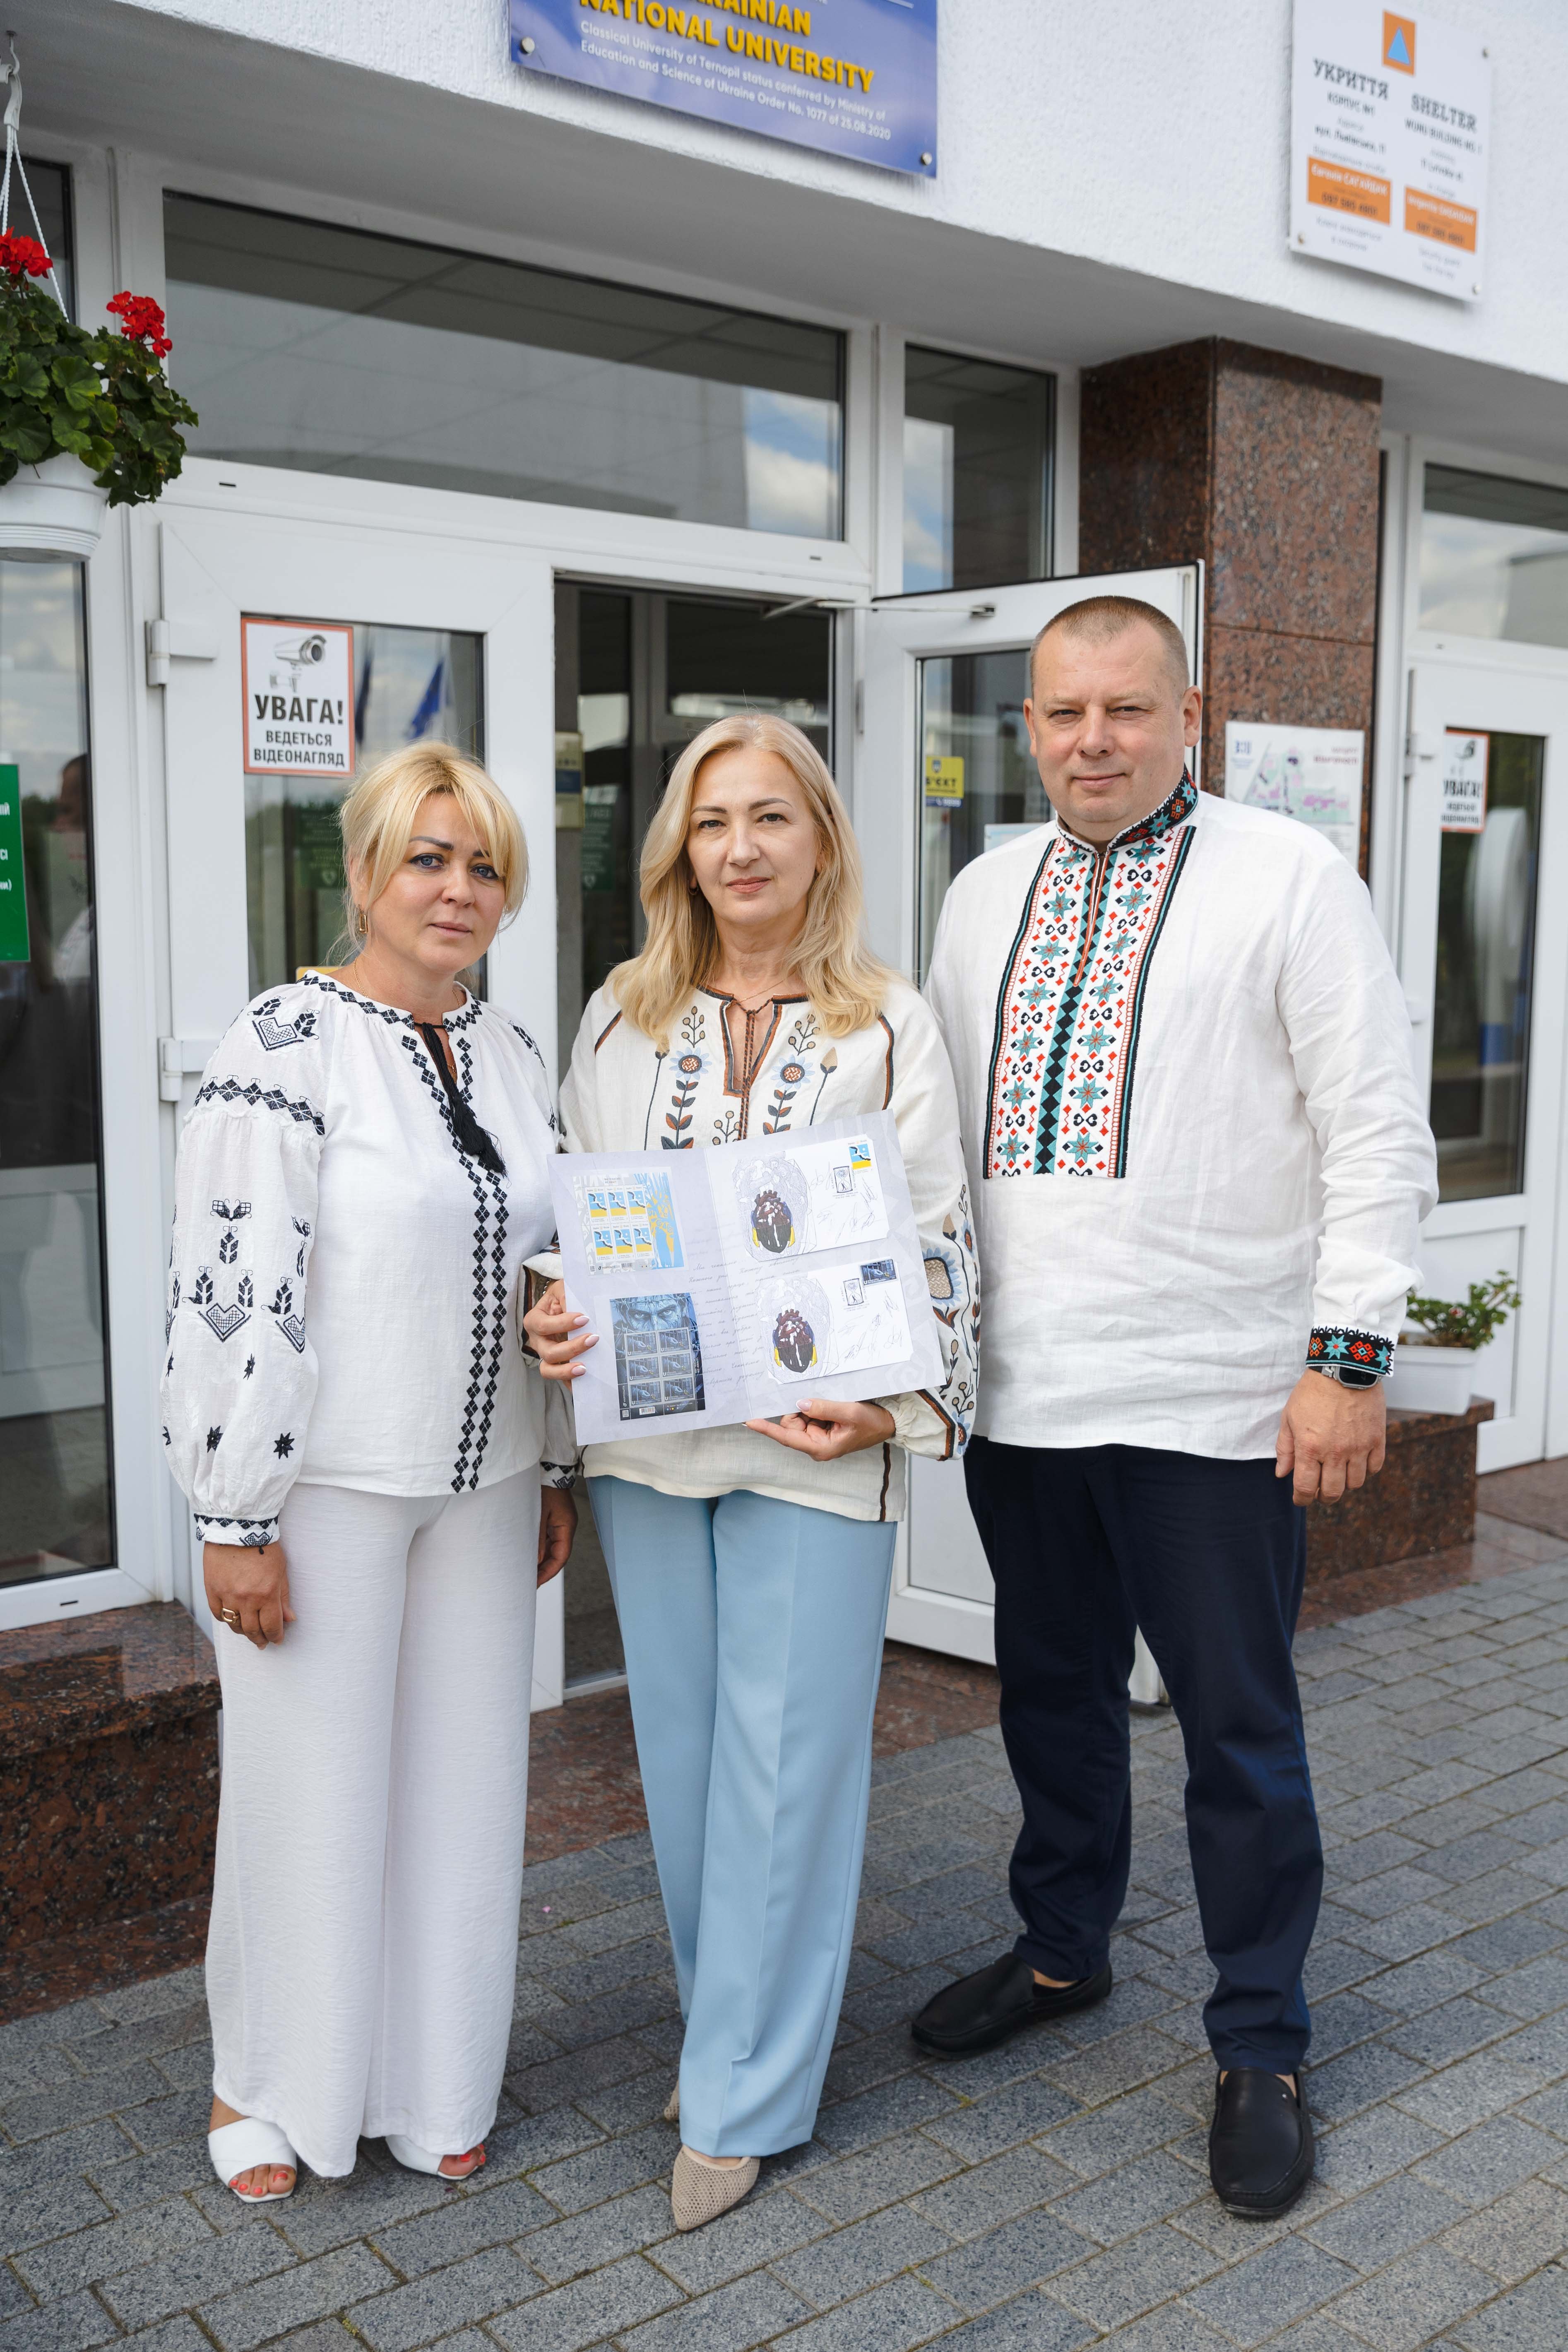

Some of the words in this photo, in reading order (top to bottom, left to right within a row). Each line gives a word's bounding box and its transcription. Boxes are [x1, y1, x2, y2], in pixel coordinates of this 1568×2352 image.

[580, 20, 630, 46] Classical
[632, 36, 684, 65] University
[686, 52, 697, 65] of
[699, 55, 740, 79] Ternopil
[742, 69, 773, 89] status
[775, 80, 822, 103] conferred
[823, 92, 837, 110] by
[837, 97, 875, 120] Ministry
[875, 110, 887, 123] of
[726, 25, 875, 94] UNIVERSITY
[1313, 57, 1388, 100] УКРИТТЯ
[581, 39, 636, 67] Education
[638, 59, 659, 74] and
[661, 63, 702, 86] Science
[704, 77, 715, 90] of
[717, 79, 755, 102] Ukraine
[757, 91, 786, 111] Order
[788, 101, 805, 117] No.
[806, 106, 828, 122] 1077
[828, 114, 839, 126] of
[1411, 93, 1478, 134] SHELTER
[254, 694, 343, 725] УВАГА!
[254, 748, 345, 767] ВІДЕОНАГЛЯД
[266, 729, 332, 747] ВЕДЕТЬСЯ
